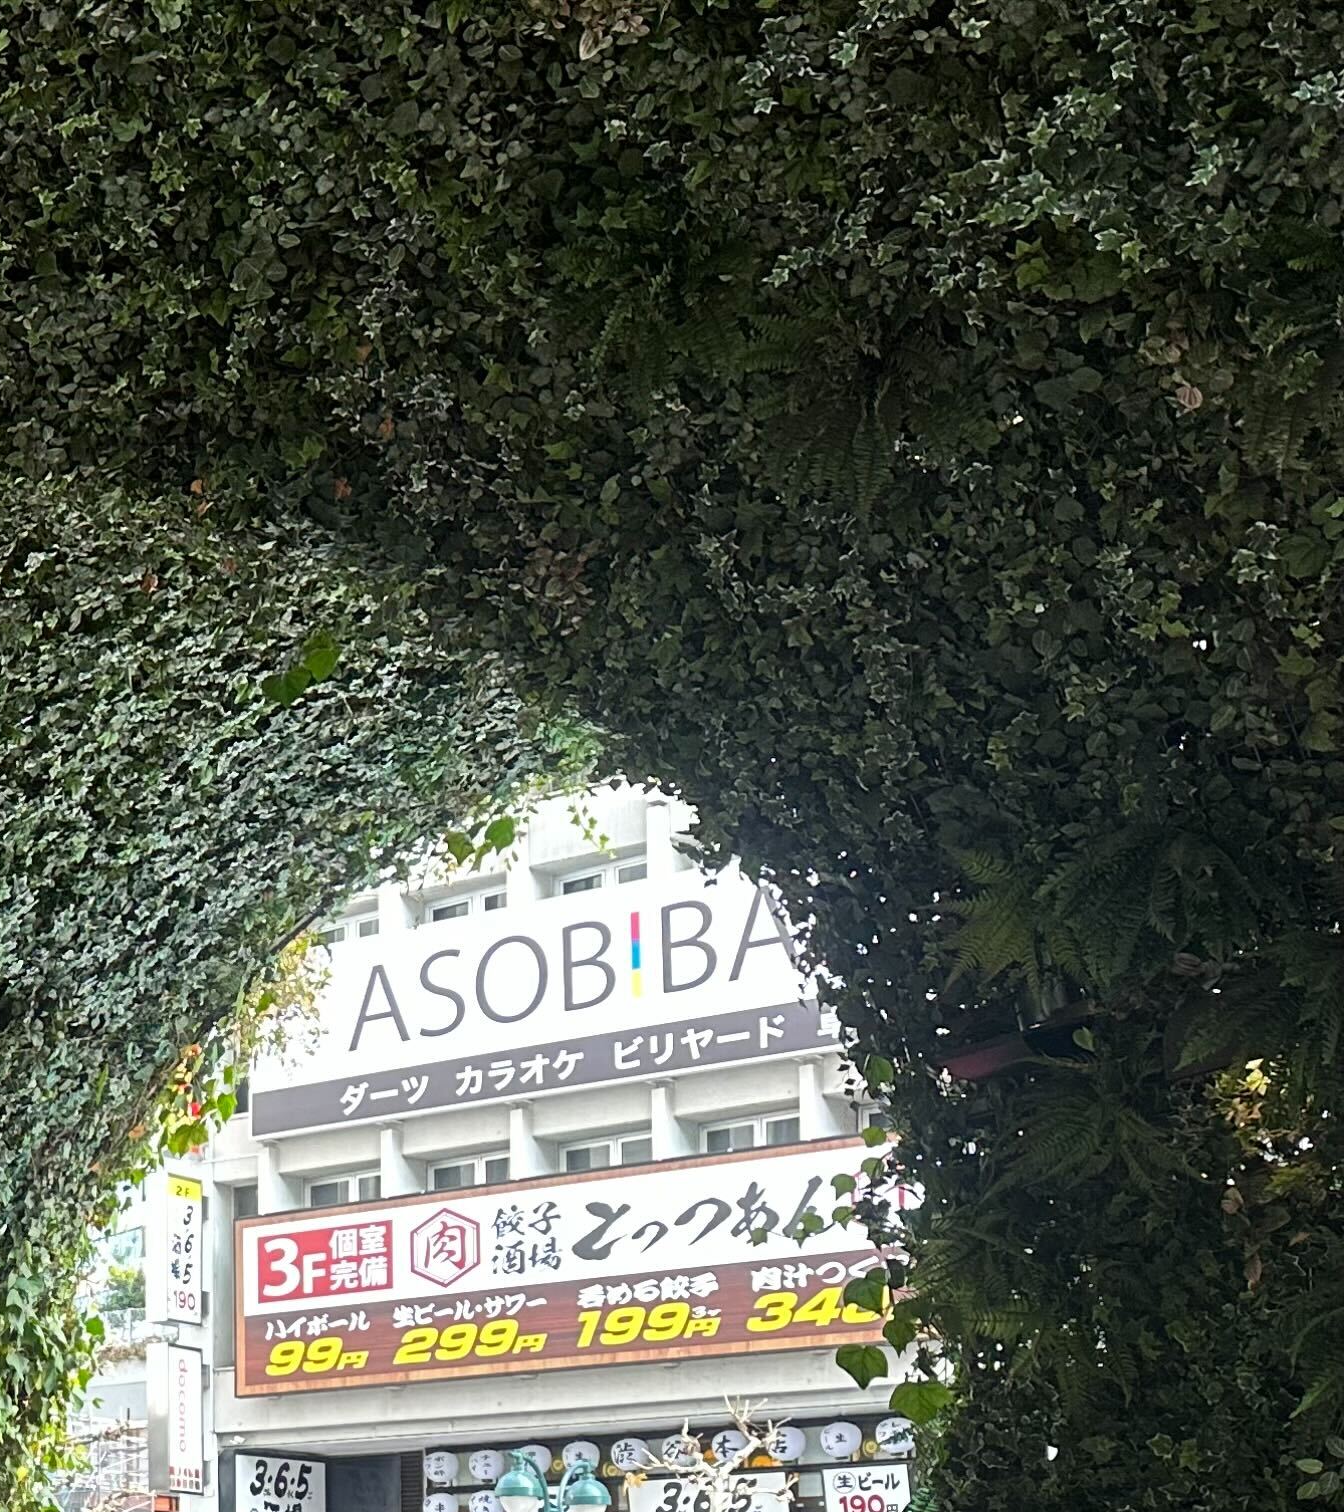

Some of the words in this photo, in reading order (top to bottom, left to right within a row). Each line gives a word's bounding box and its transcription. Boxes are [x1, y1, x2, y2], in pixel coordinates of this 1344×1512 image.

[348, 886, 798, 1051] ASOBIBA
[340, 1073, 431, 1116] ダーツ
[455, 1049, 584, 1096] カラオケ
[614, 1014, 785, 1069] ビリヤード
[492, 1202, 561, 1239] 餃子
[330, 1225, 387, 1258] 個室
[424, 1221, 466, 1270] 肉
[492, 1237, 562, 1275] 酒場
[263, 1238, 326, 1297] 3F
[330, 1256, 388, 1291] 完備
[265, 1311, 370, 1340] ハイボール
[393, 1319, 548, 1365] 299円
[577, 1302, 722, 1348] 199円
[265, 1336, 369, 1376] 99円
[833, 1471, 900, 1494] 生ビール
